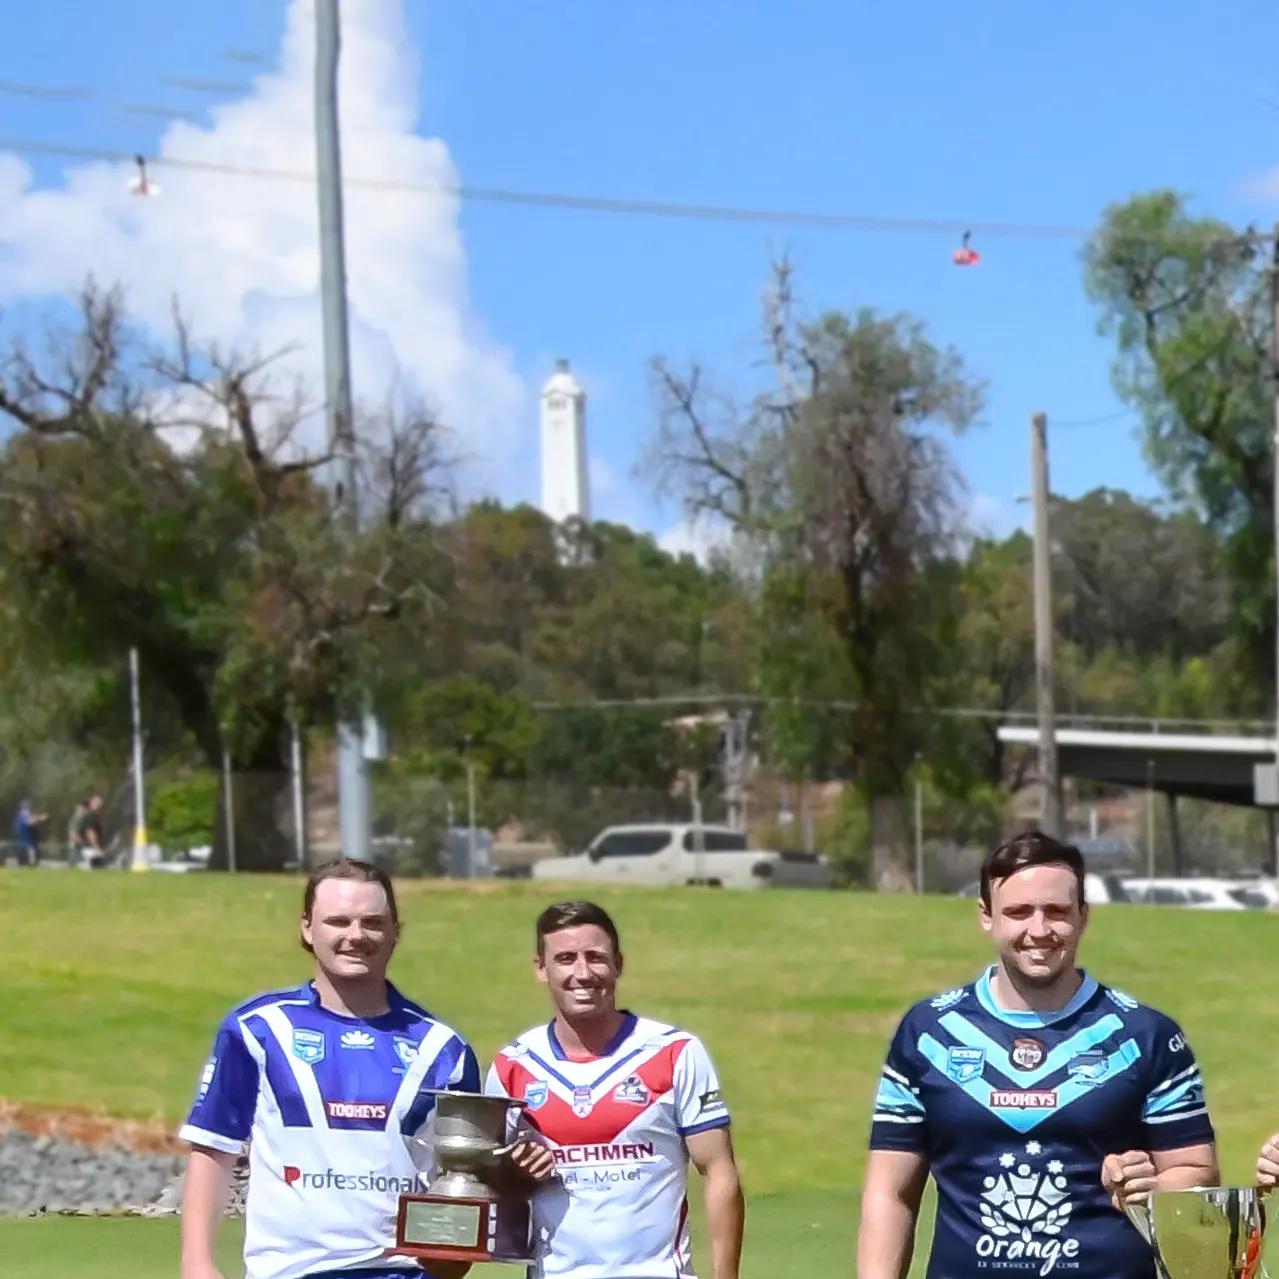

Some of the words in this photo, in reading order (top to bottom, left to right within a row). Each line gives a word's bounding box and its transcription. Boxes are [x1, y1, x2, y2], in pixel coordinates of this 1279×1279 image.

[992, 1091, 1056, 1107] TOOHEYS
[328, 1102, 388, 1120] TOOHEYS
[552, 1141, 655, 1165] ACHMAN
[975, 1234, 1080, 1277] Orange
